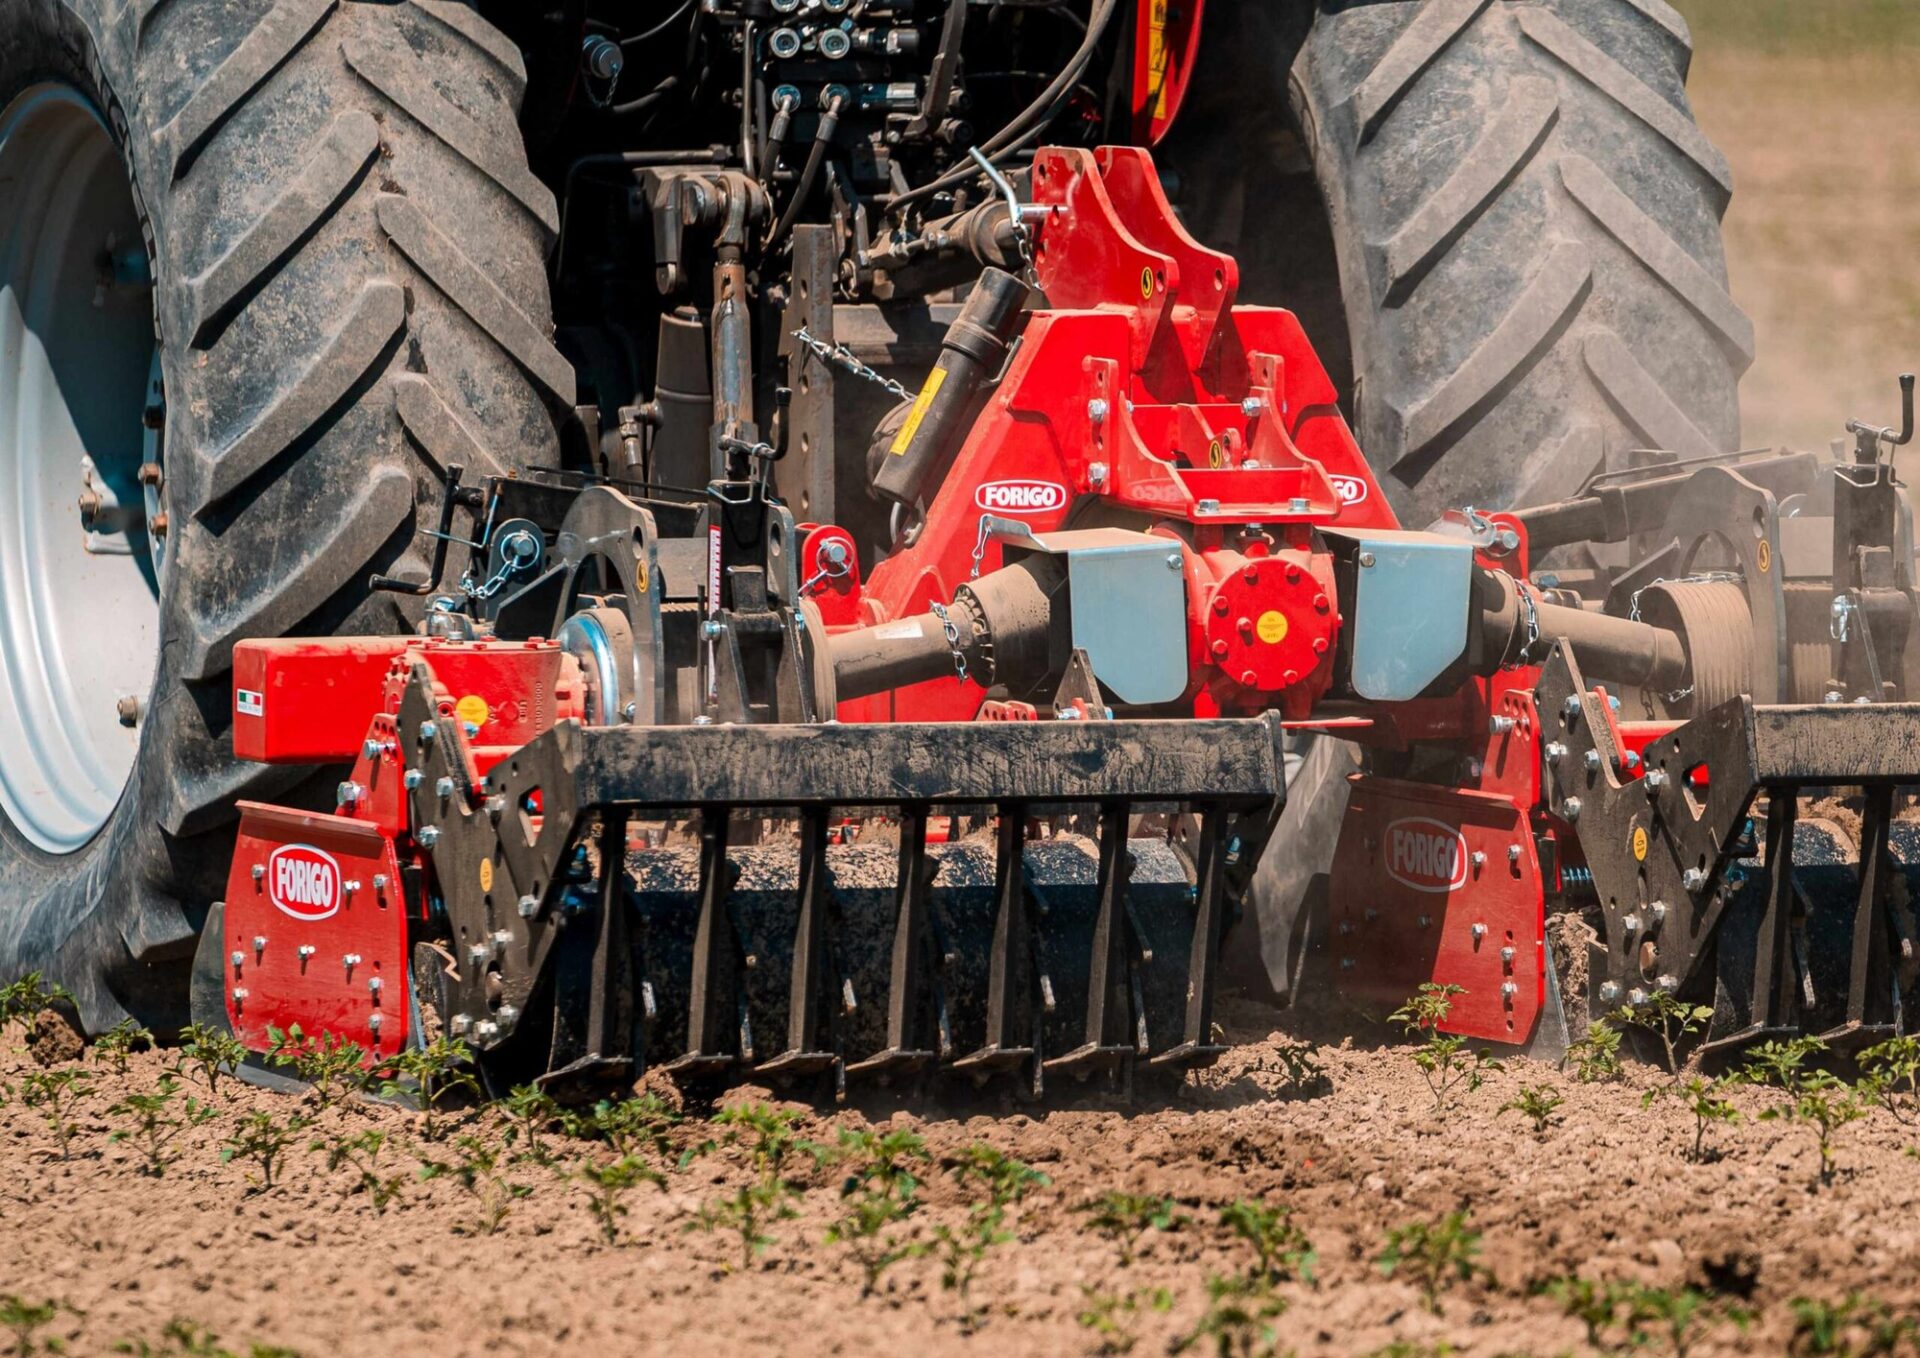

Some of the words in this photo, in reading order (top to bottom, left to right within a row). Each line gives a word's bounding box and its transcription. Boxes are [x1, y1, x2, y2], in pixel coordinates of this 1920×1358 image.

[985, 486, 1057, 507] FORIGO
[1393, 829, 1459, 881] FORIGO
[276, 857, 333, 908] FORIGO
